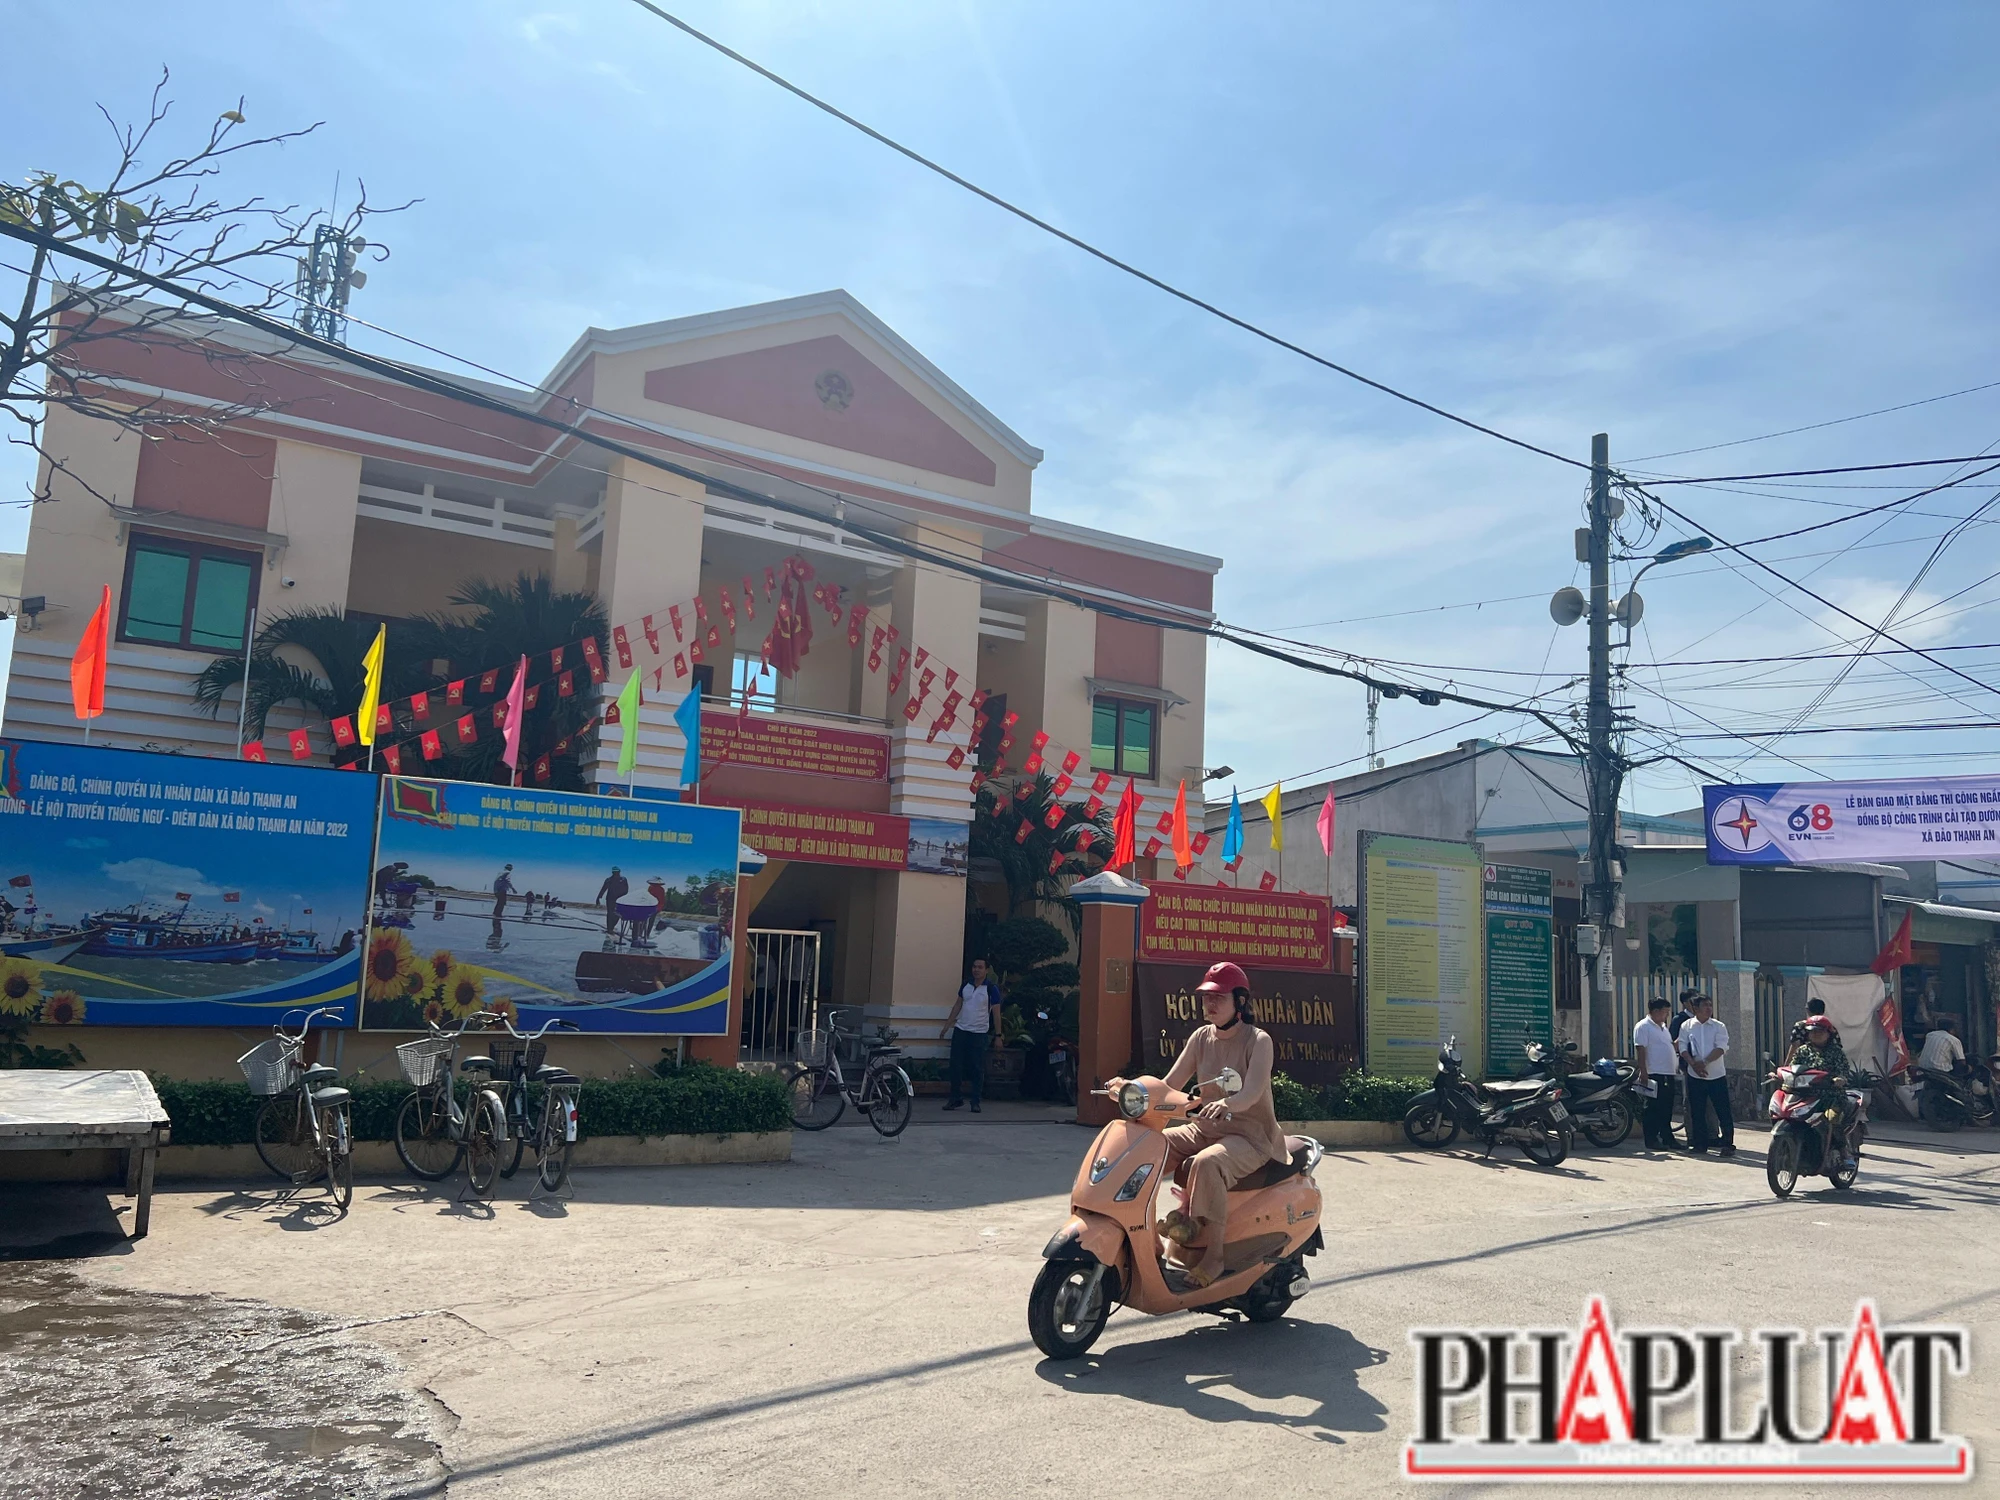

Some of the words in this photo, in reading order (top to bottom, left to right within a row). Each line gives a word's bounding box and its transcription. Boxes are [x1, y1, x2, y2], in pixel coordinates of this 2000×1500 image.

[30, 770, 58, 792] ĐẢNG
[61, 775, 77, 795] BỘ,
[81, 777, 112, 796] CHÍNH
[114, 778, 147, 798] QUYỀN
[150, 781, 161, 799] VÀ
[164, 784, 192, 801] NHÂN
[194, 786, 214, 803] DÂN
[216, 787, 228, 804] XÃ
[231, 786, 250, 806] ĐẢO
[252, 792, 282, 810] THẠNH
[284, 795, 297, 809] AN
[1846, 794, 1855, 808] LỄ
[1856, 795, 1874, 808] BÀN
[1876, 796, 1894, 808] GIAO
[1897, 794, 1914, 808] MẶT
[1916, 790, 1938, 806] BẰNG
[1940, 793, 1954, 805] THI
[1955, 790, 1978, 804] CÔNG
[31, 796, 44, 816] LỄ
[46, 798, 64, 820] HỘI
[67, 800, 104, 820] TRUYỀN
[108, 802, 140, 822] THỐNG
[142, 808, 164, 824] NGƯ
[172, 808, 196, 827] DIÊM
[198, 810, 218, 828] DÂN
[221, 812, 234, 830] XÃ
[236, 812, 254, 831] ĐẢO
[258, 816, 286, 835] THẠNH
[288, 820, 301, 834] AN
[304, 818, 324, 836] NĂM
[326, 822, 348, 837] 2022
[1788, 804, 1834, 832] 68
[1857, 811, 1879, 826] ĐỒNG
[1882, 812, 1892, 827] BỘ
[1894, 812, 1916, 824] CÔNG
[1918, 810, 1942, 824] TRÌNH
[1944, 808, 1958, 823] CẢI
[1960, 811, 1976, 824] TẠO
[1922, 829, 1933, 842] XÃ
[1935, 828, 1951, 842] ĐẢO
[1953, 830, 1980, 844] THẠNH
[1984, 830, 1995, 840] AN
[1252, 992, 1296, 1024] NHÂN
[1301, 994, 1334, 1026] DÂN
[1160, 1029, 1176, 1057] ỦY
[1279, 1038, 1294, 1060] XÃ
